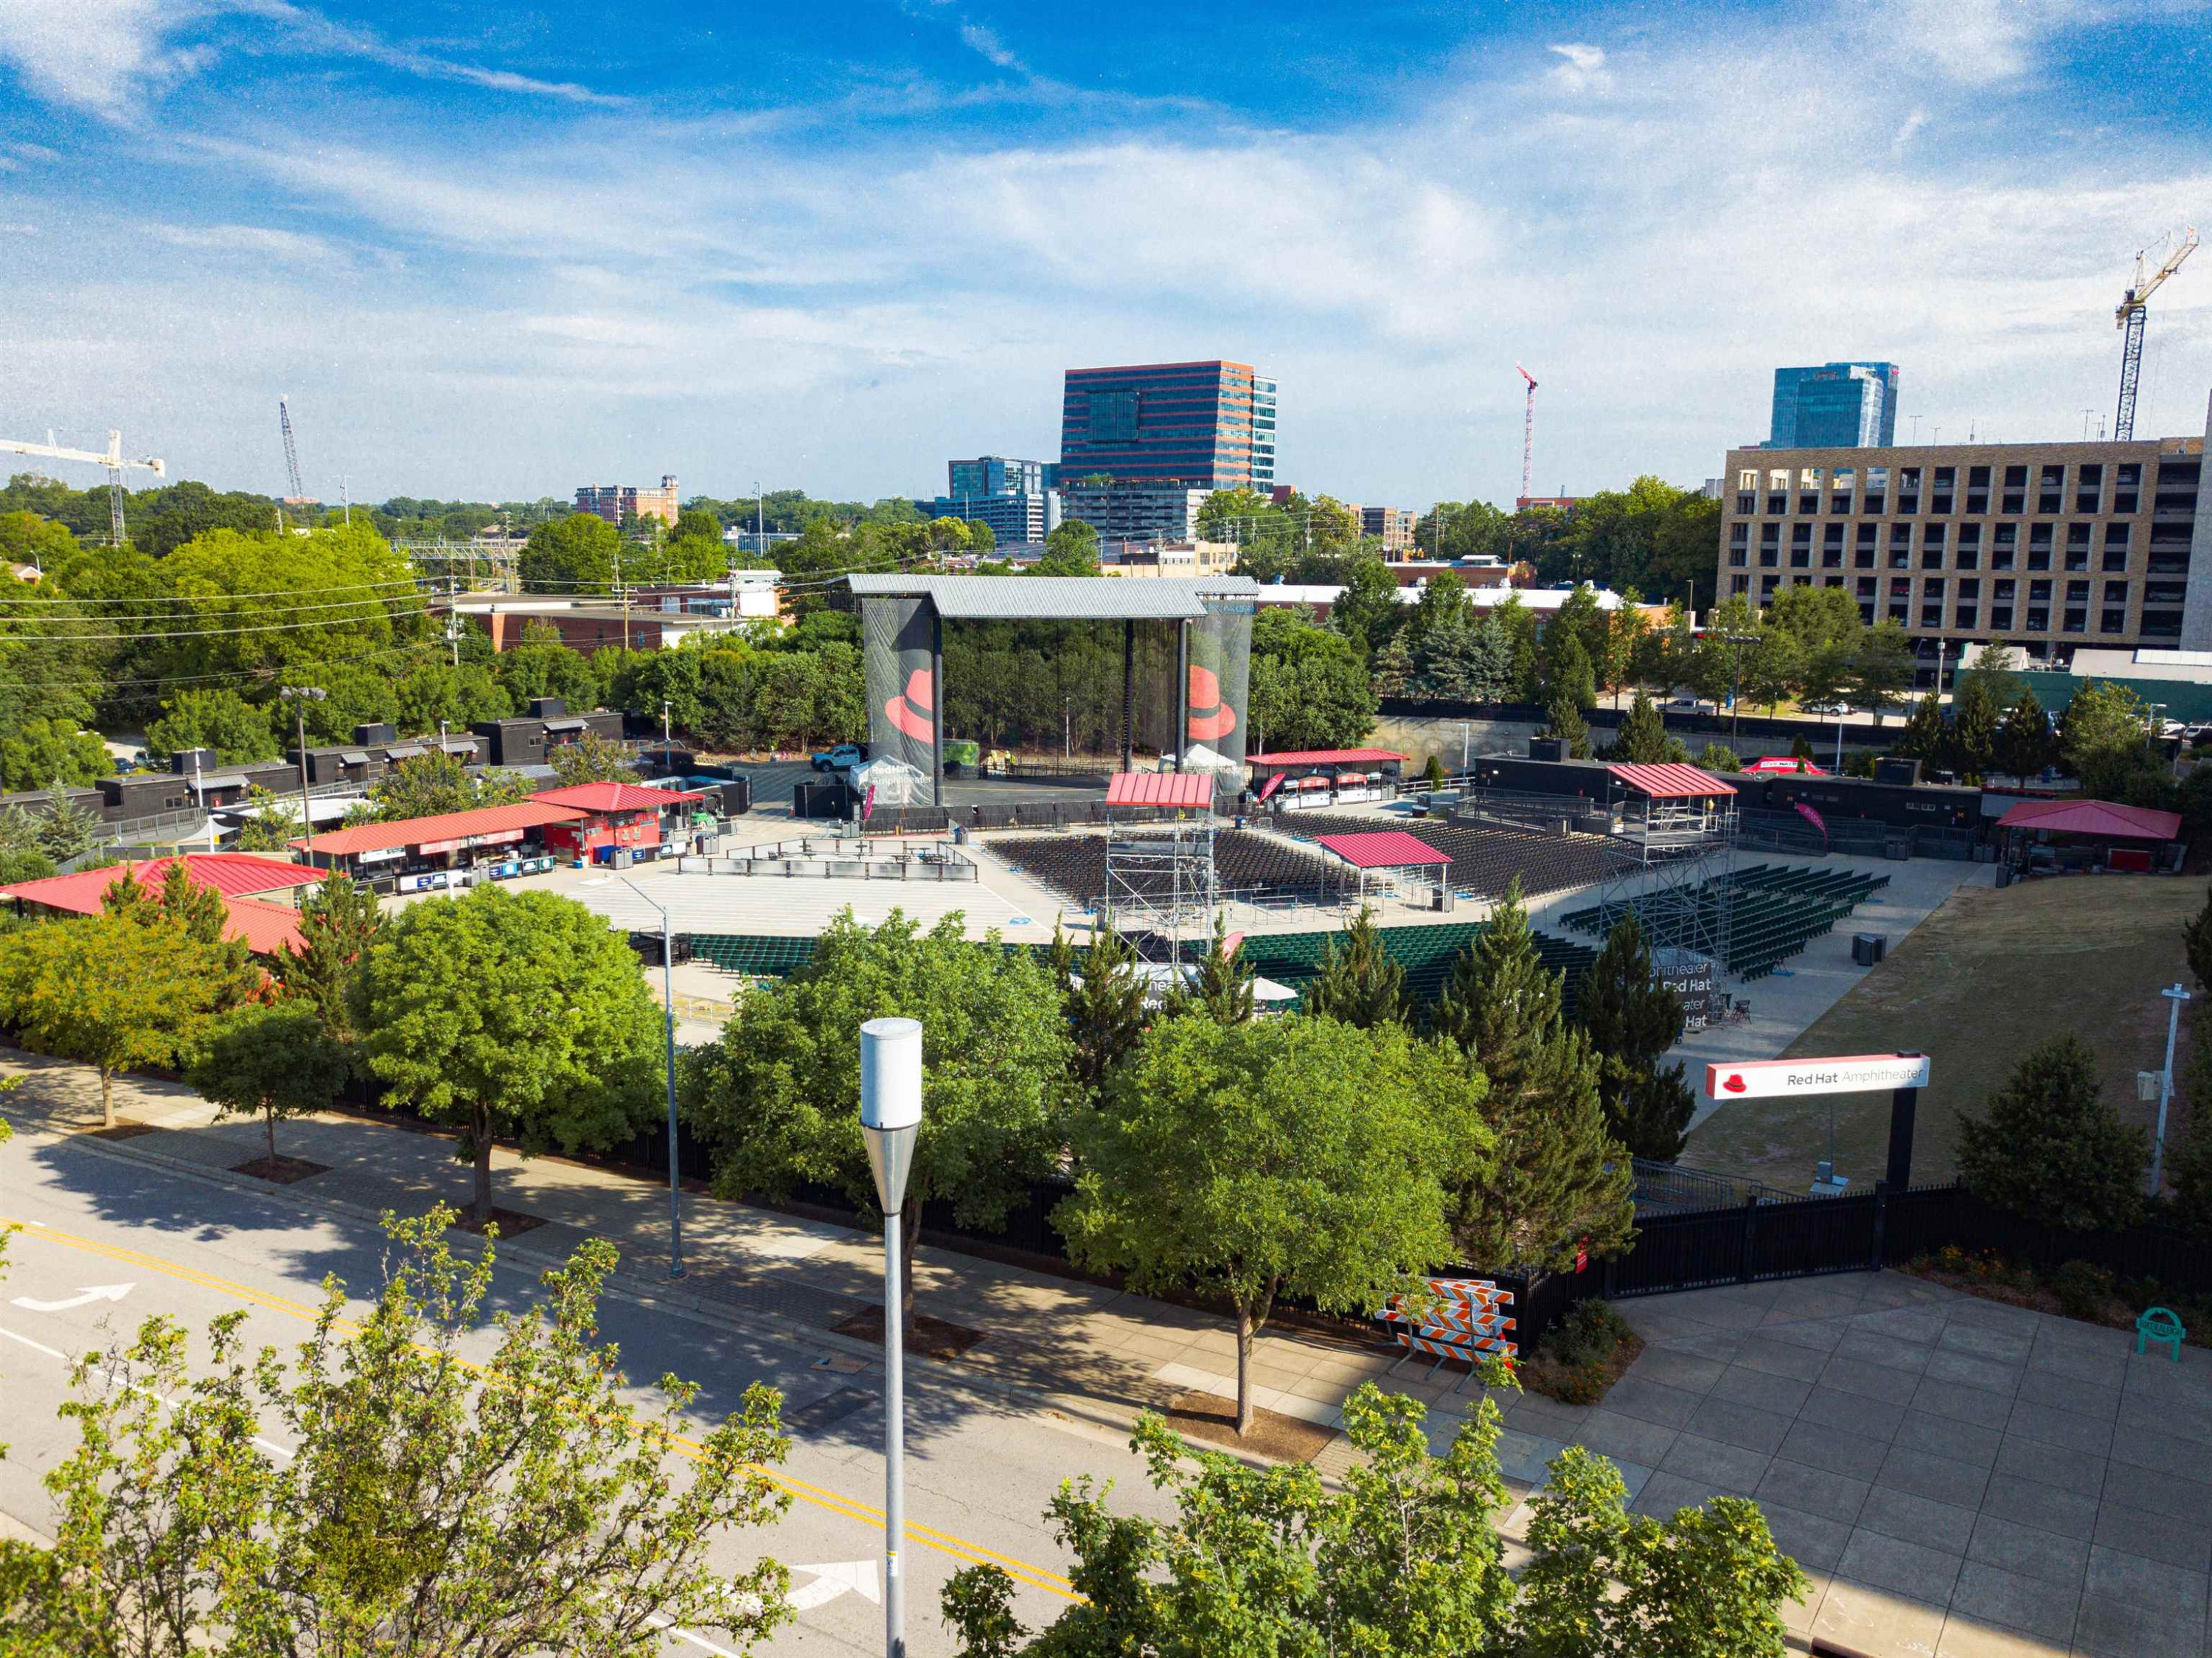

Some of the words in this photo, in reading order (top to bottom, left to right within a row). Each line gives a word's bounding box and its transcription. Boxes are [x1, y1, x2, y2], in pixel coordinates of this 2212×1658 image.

[1690, 979, 1711, 992] Hat
[1686, 1015, 1708, 1027] Hat
[1787, 1074, 1813, 1086] Red
[1815, 1072, 1838, 1084] Hat
[1843, 1069, 1924, 1083] Amphitheater
